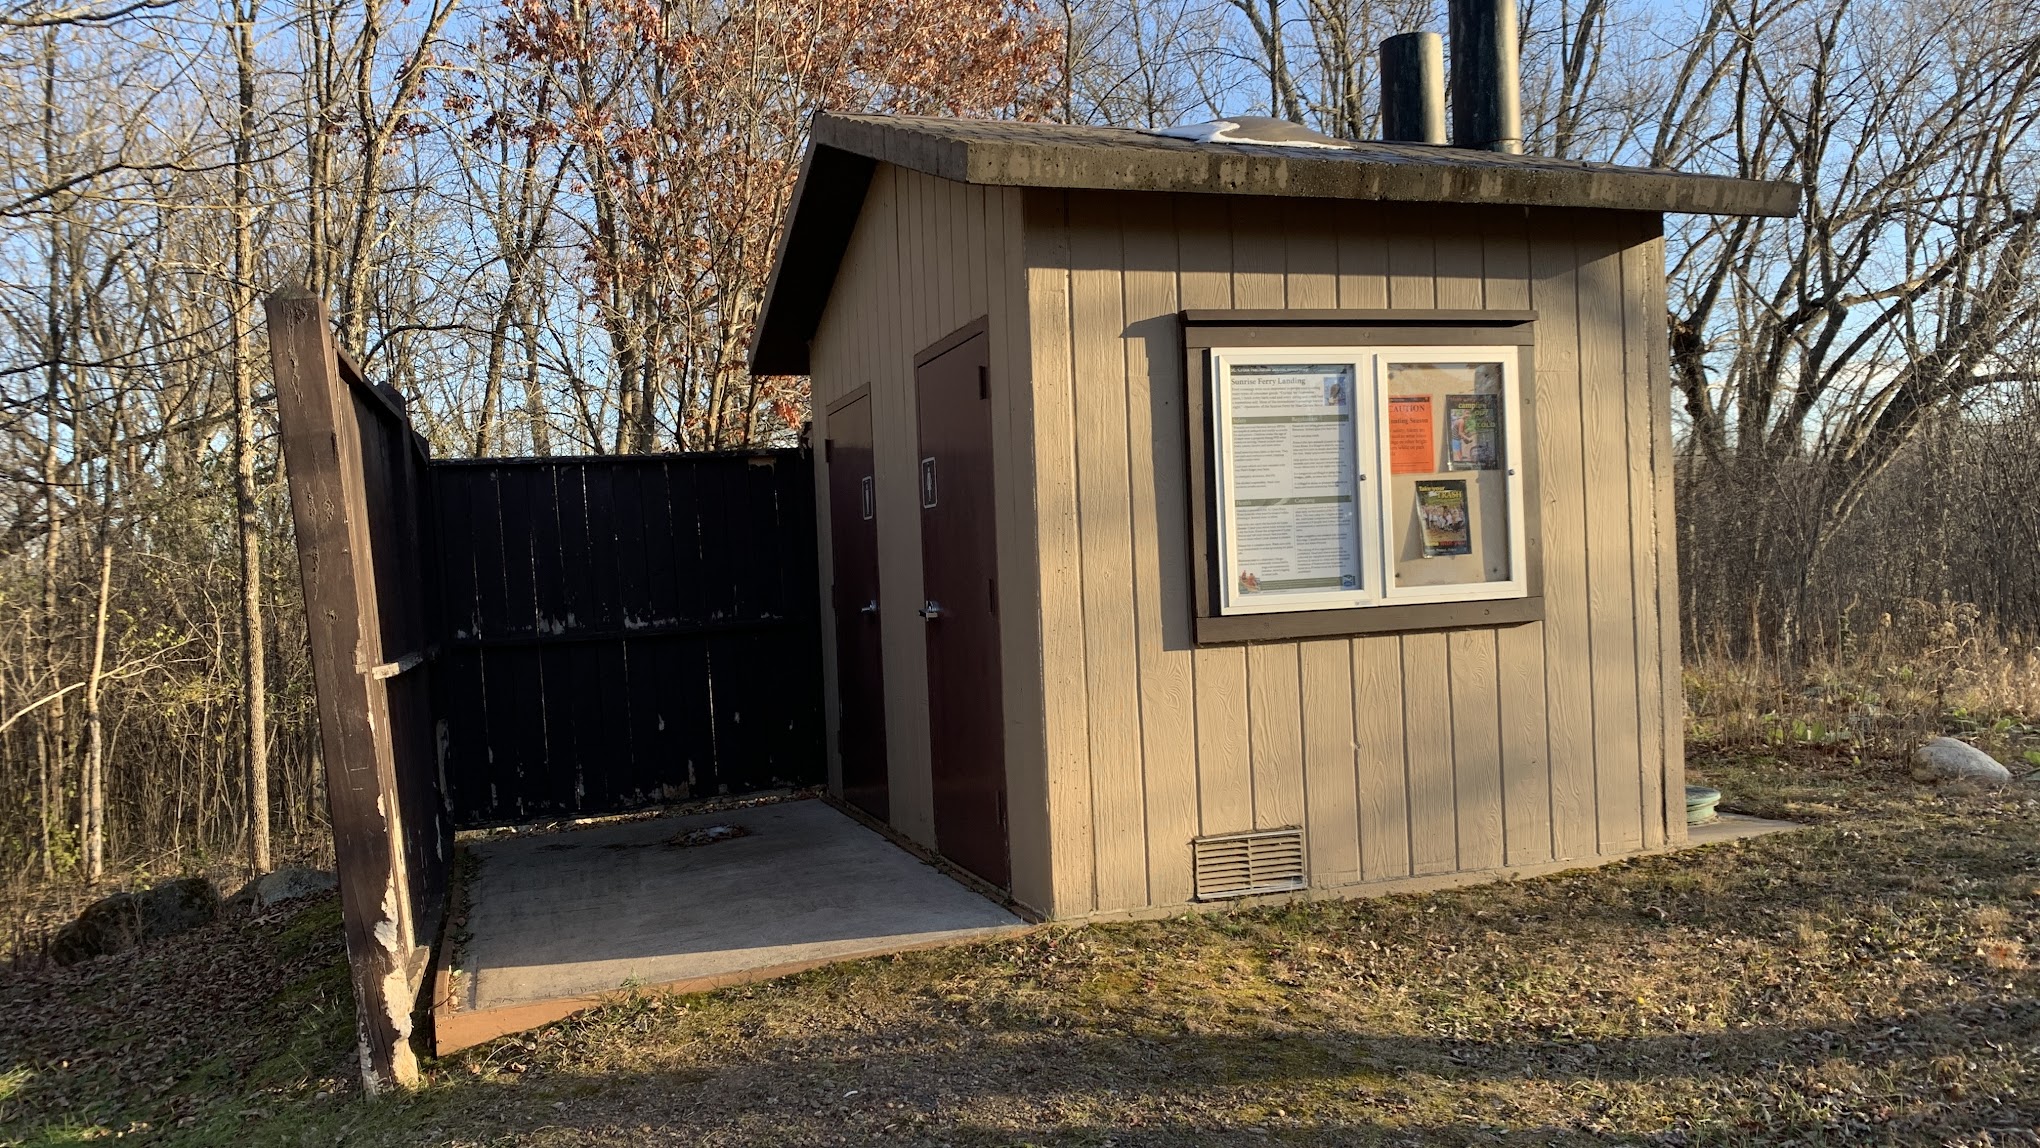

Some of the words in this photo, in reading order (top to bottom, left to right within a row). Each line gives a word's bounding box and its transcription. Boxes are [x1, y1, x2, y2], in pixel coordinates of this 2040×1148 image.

[1231, 378, 1257, 386] Sunrise
[1258, 377, 1277, 387] Ferry
[1278, 377, 1306, 386] Landing
[1437, 490, 1463, 498] TRASH
